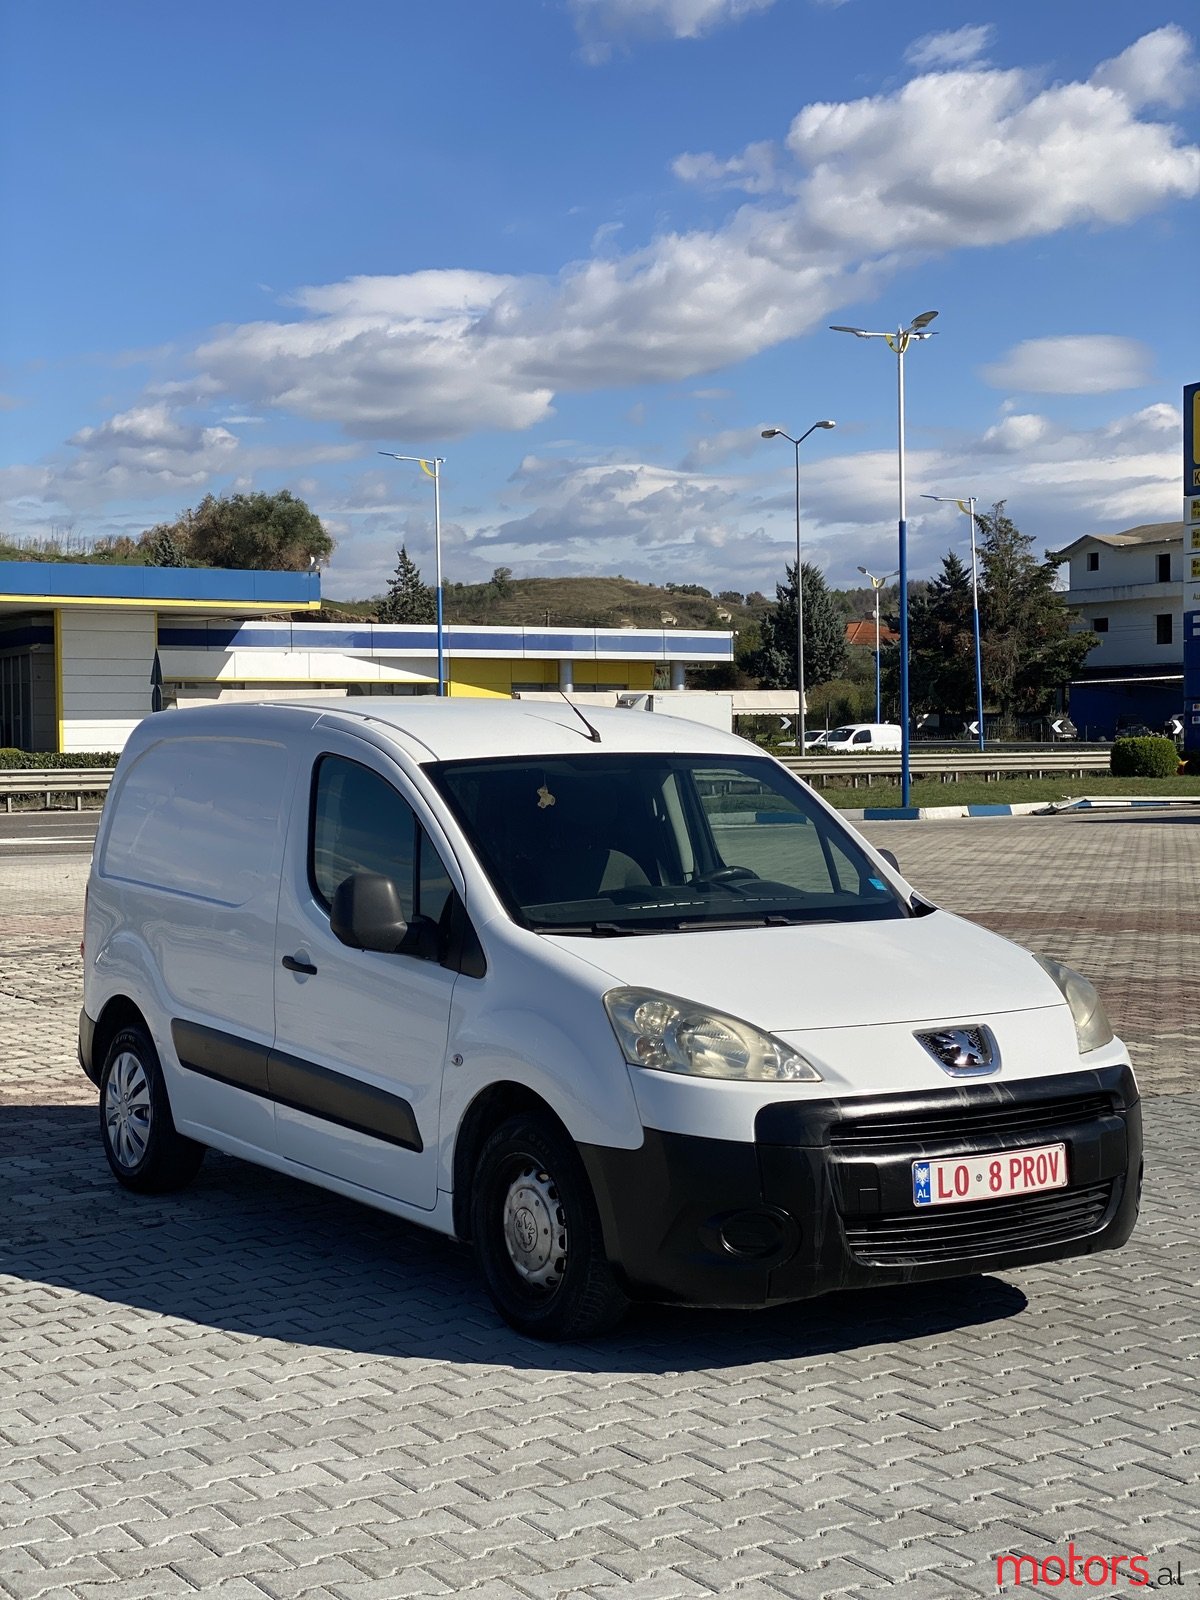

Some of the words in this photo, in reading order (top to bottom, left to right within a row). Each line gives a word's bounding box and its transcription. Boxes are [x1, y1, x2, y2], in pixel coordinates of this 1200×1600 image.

[989, 1160, 1003, 1192] 8
[1009, 1151, 1059, 1190] PROV
[917, 1188, 930, 1198] AL
